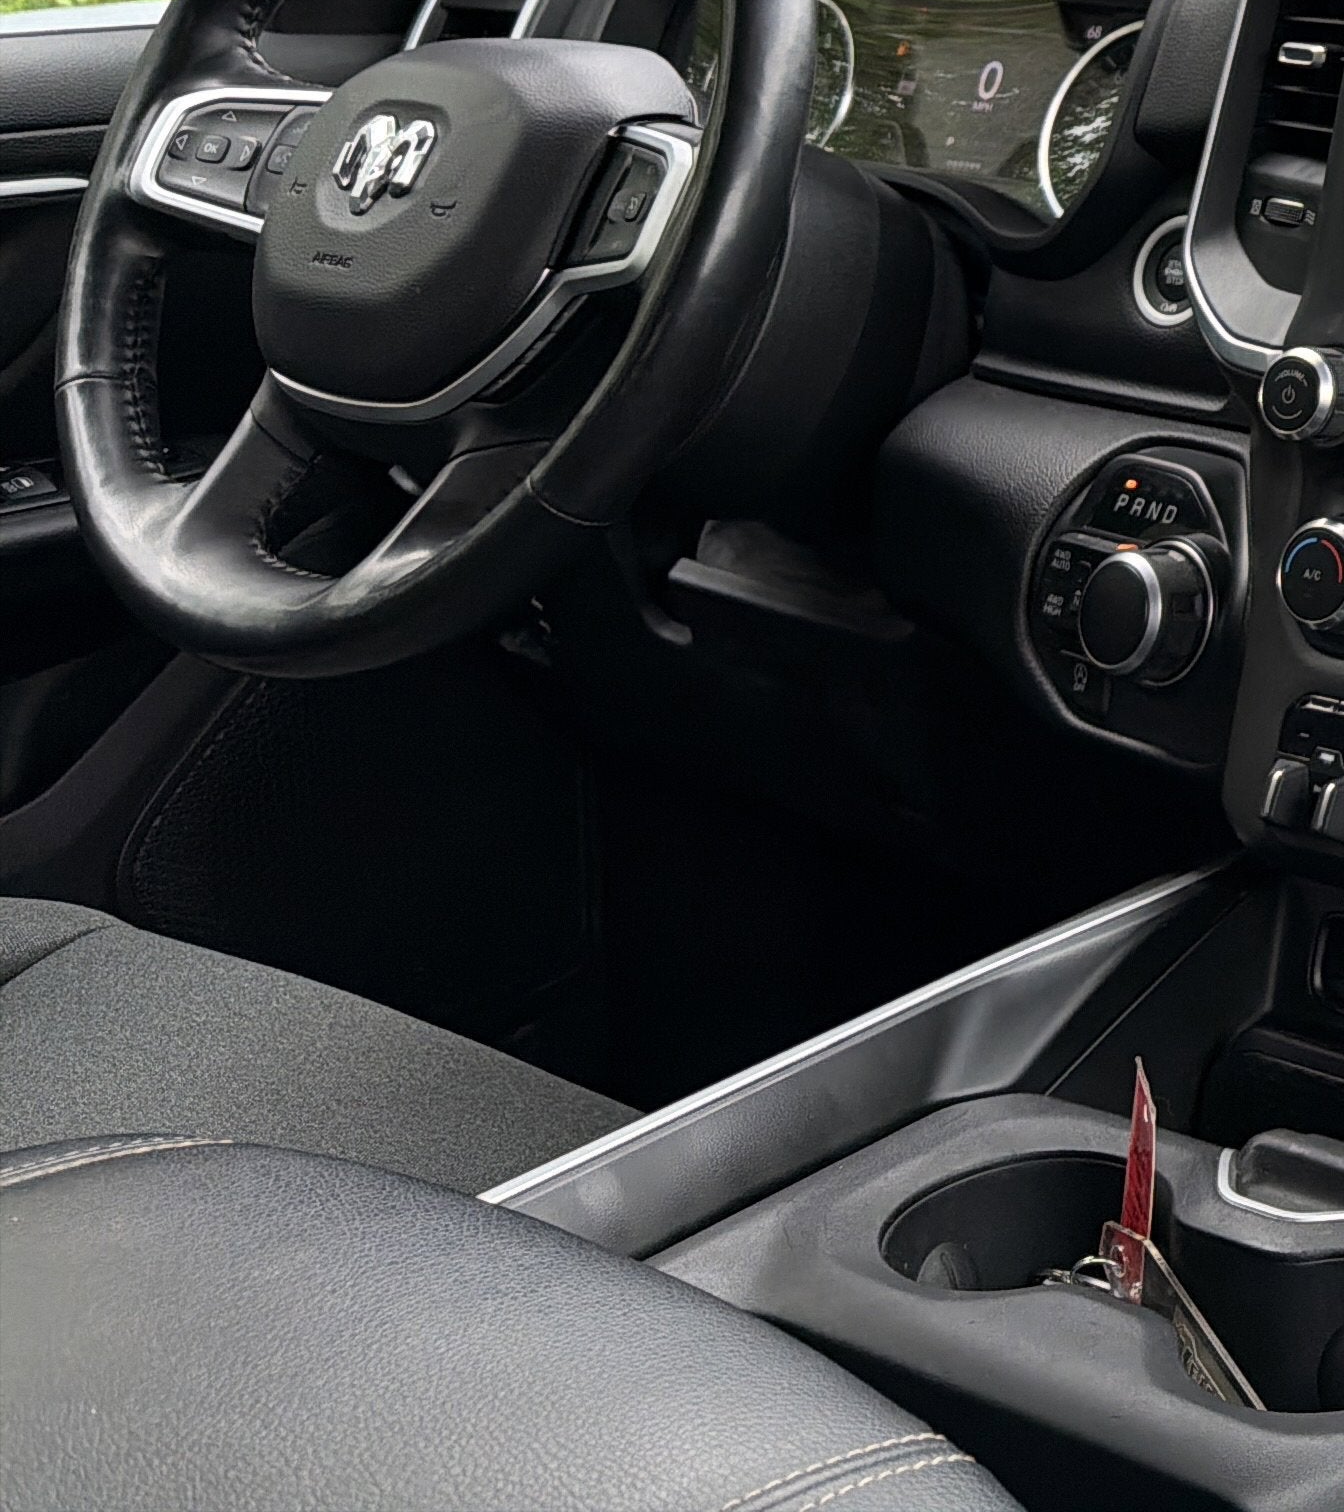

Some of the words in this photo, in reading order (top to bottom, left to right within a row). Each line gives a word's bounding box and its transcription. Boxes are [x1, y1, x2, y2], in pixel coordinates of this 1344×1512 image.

[977, 60, 1004, 100] 0
[204, 142, 218, 154] OK
[312, 251, 354, 269] AIRBAG
[1278, 369, 1305, 381] VOLUME
[1303, 567, 1322, 581] A/C
